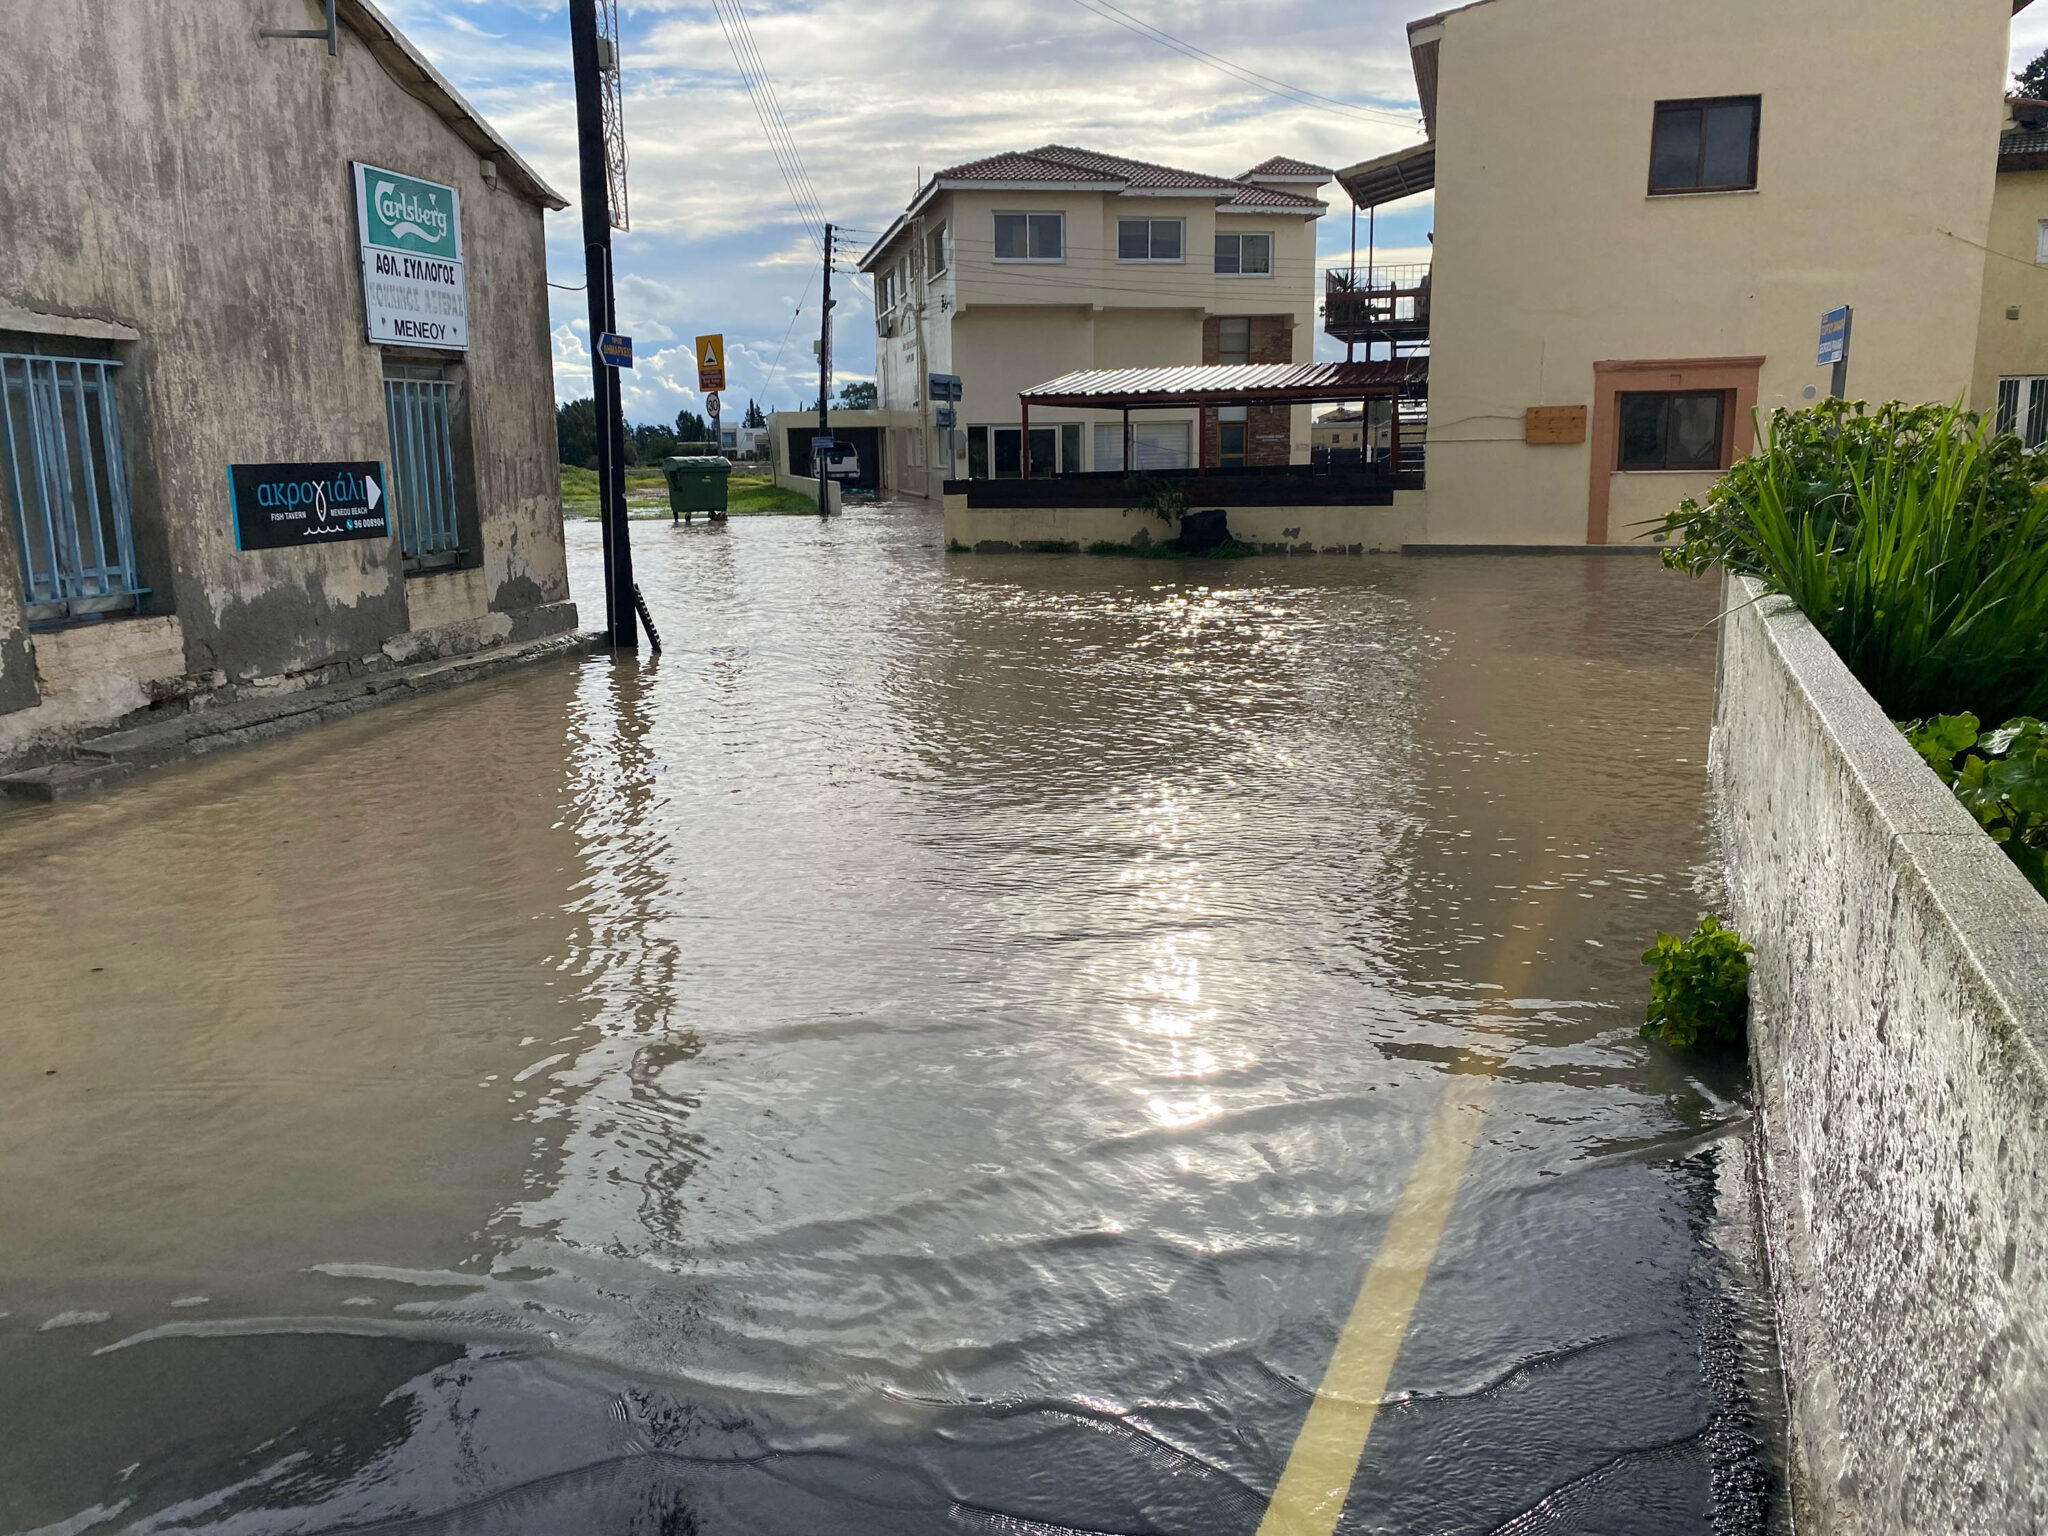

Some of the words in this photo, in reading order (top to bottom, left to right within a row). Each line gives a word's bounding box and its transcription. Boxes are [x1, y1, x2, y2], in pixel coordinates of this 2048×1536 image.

[374, 180, 447, 237] Carlsberg
[376, 253, 401, 275] ΑΘΛ.
[404, 258, 455, 285] ΣΥΛΛΟΓΟΣ
[394, 319, 446, 340] ΜΕΝΕΟΥ
[708, 399, 718, 411] 30
[270, 512, 285, 521] FISH
[285, 511, 307, 520] TAVERN
[330, 508, 351, 517] MENEOU
[351, 506, 368, 516] BEACH
[353, 519, 363, 529] 96
